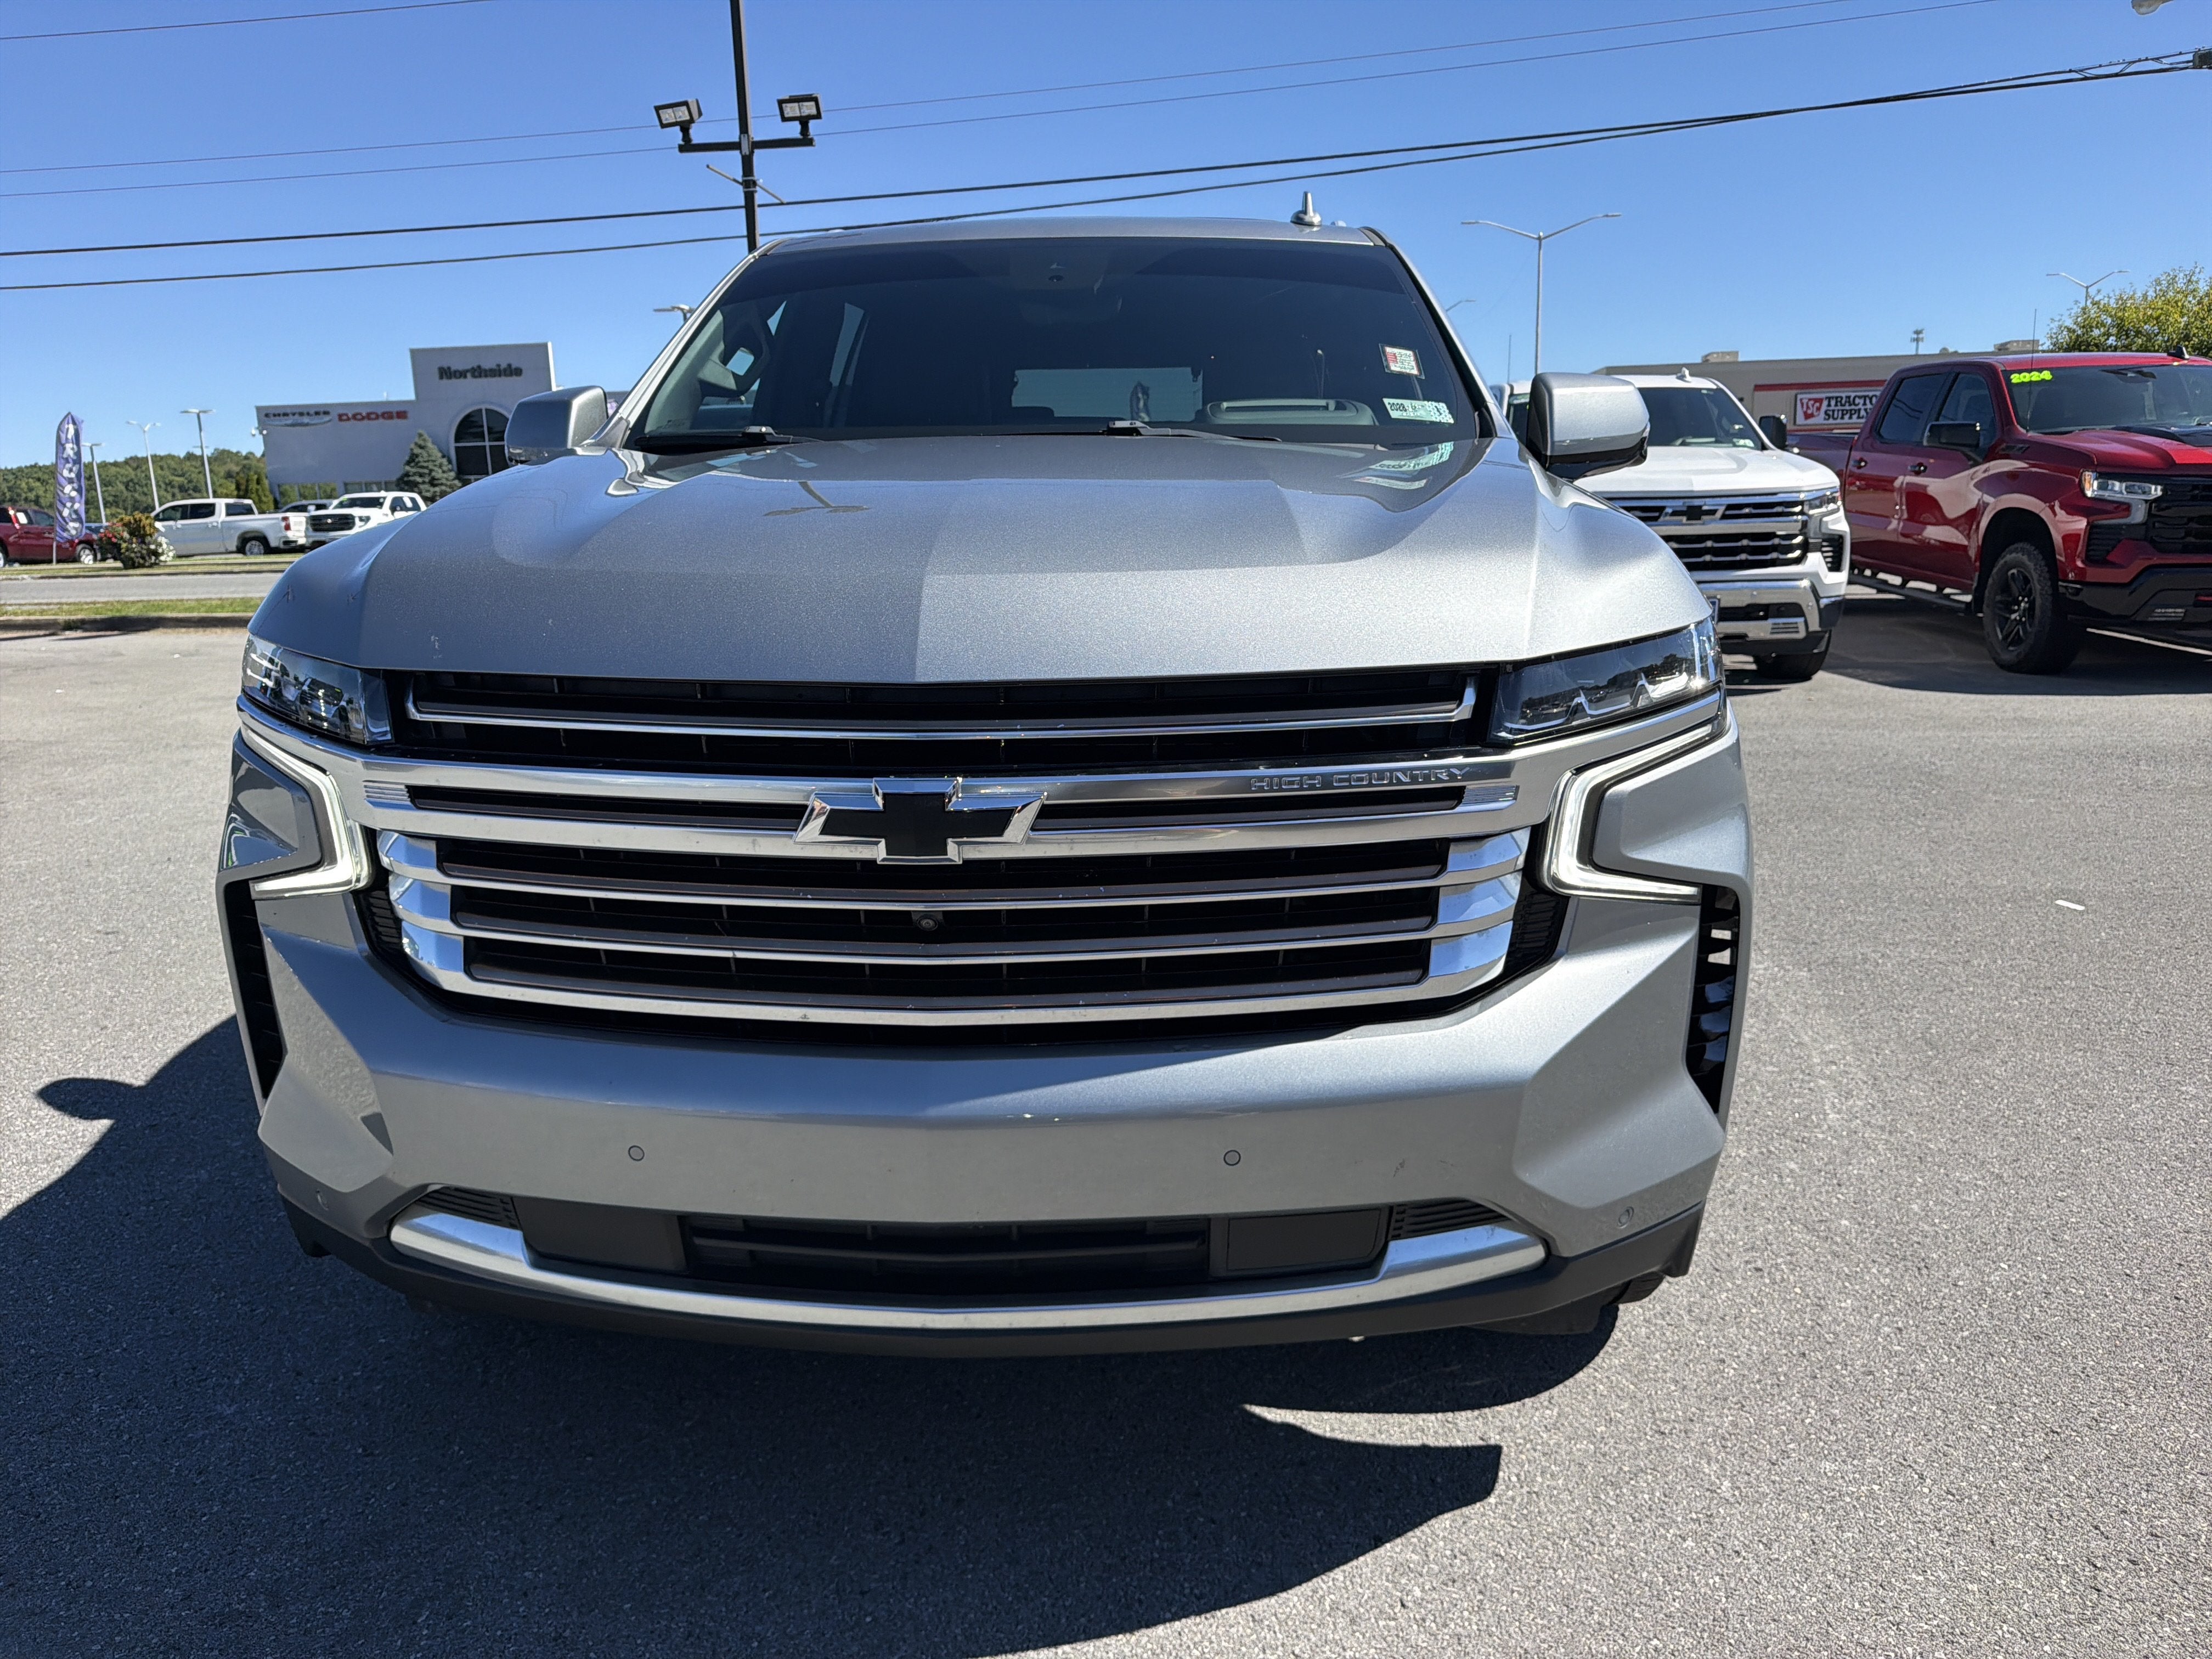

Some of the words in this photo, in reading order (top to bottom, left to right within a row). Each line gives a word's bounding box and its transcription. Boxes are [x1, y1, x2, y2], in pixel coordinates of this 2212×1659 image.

[438, 363, 522, 380] Northside
[2010, 370, 2052, 383] 2024
[1802, 398, 1820, 416] TSC
[1825, 394, 1878, 407] TRACTO
[337, 410, 408, 422] DODGE
[1251, 775, 1322, 790] HIGH
[1333, 767, 1471, 787] COUNTRY
